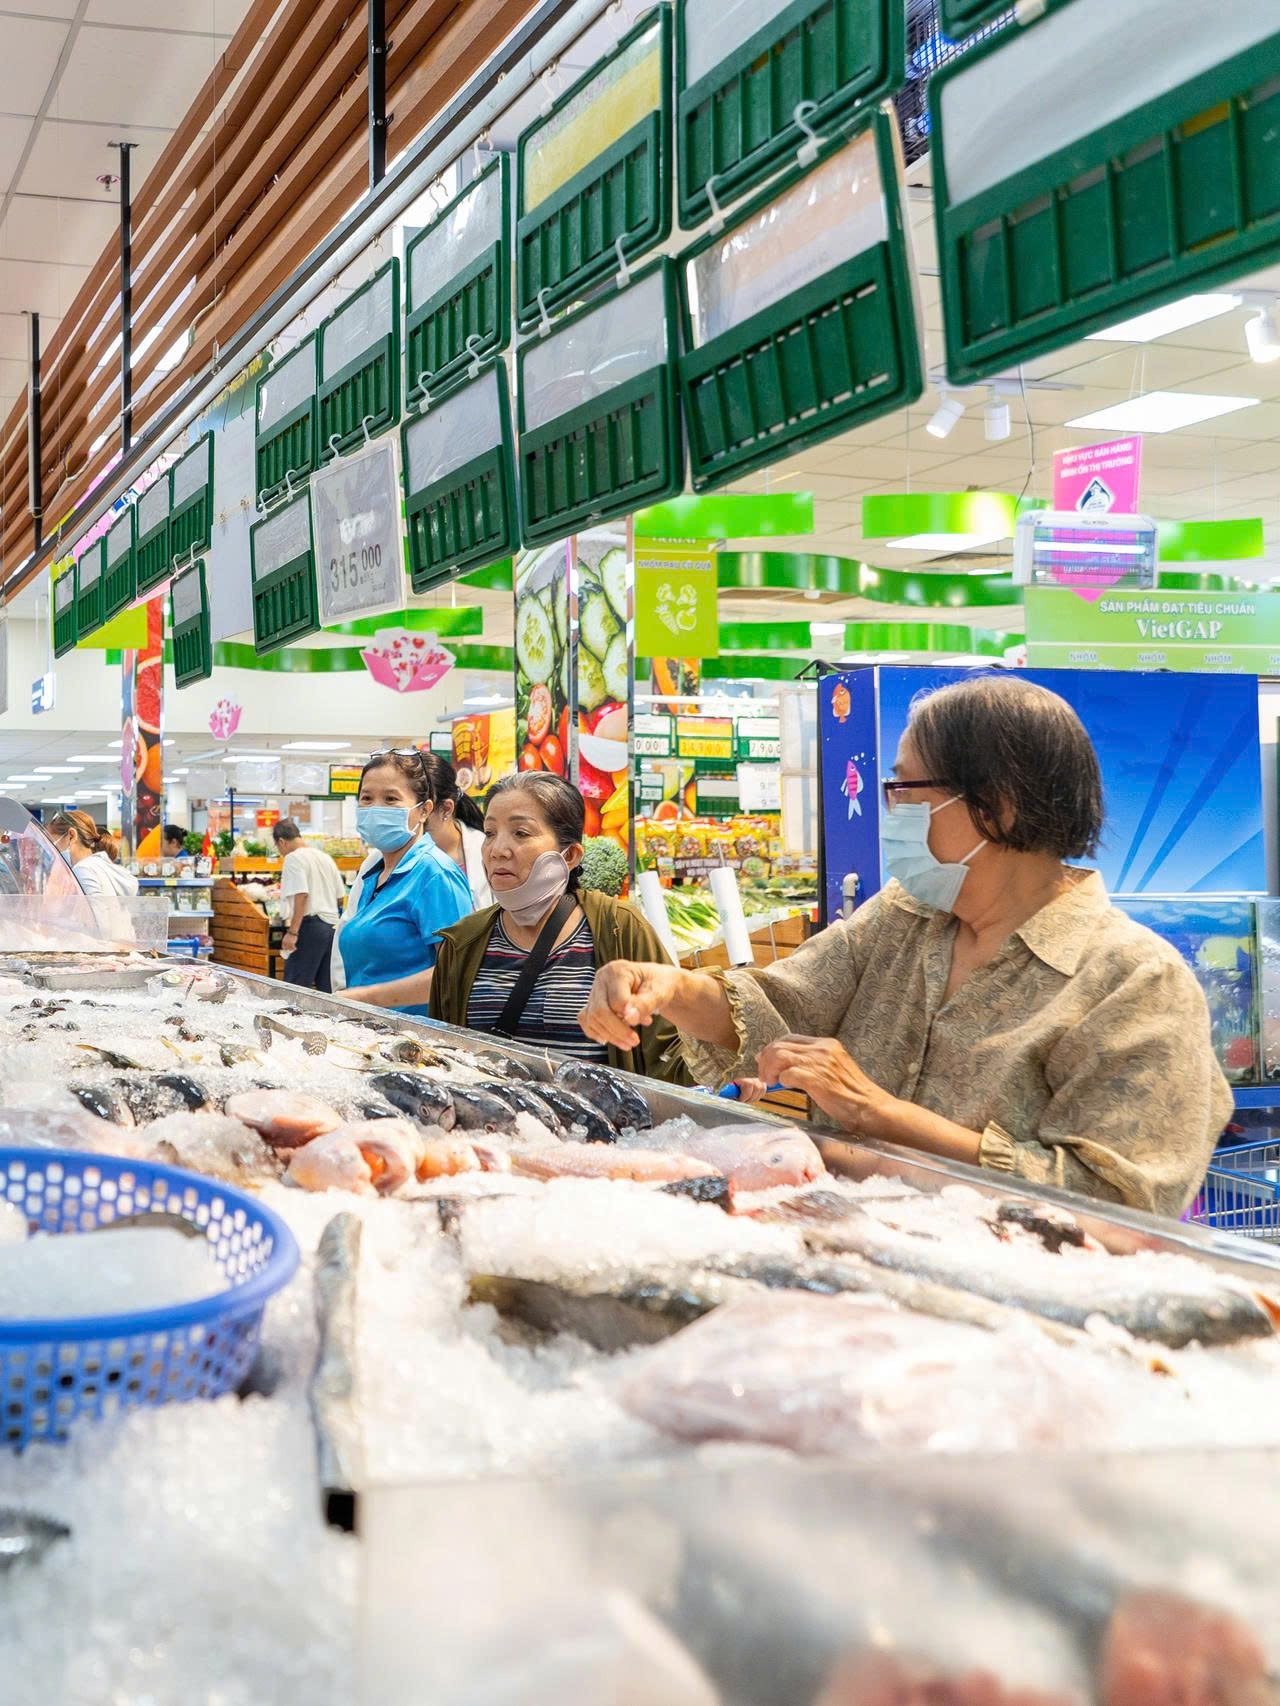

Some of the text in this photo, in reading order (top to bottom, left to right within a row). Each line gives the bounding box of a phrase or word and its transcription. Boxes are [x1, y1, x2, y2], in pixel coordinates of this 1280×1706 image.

[1100, 599, 1123, 613] SẢN
[1126, 598, 1159, 613] PHẨM
[1162, 602, 1185, 616] ĐẠT
[1136, 619, 1223, 640] VietGAP
[1070, 651, 1098, 663] NHÓM
[1138, 651, 1166, 664] NHÓM
[1205, 653, 1232, 664] NHÓM
